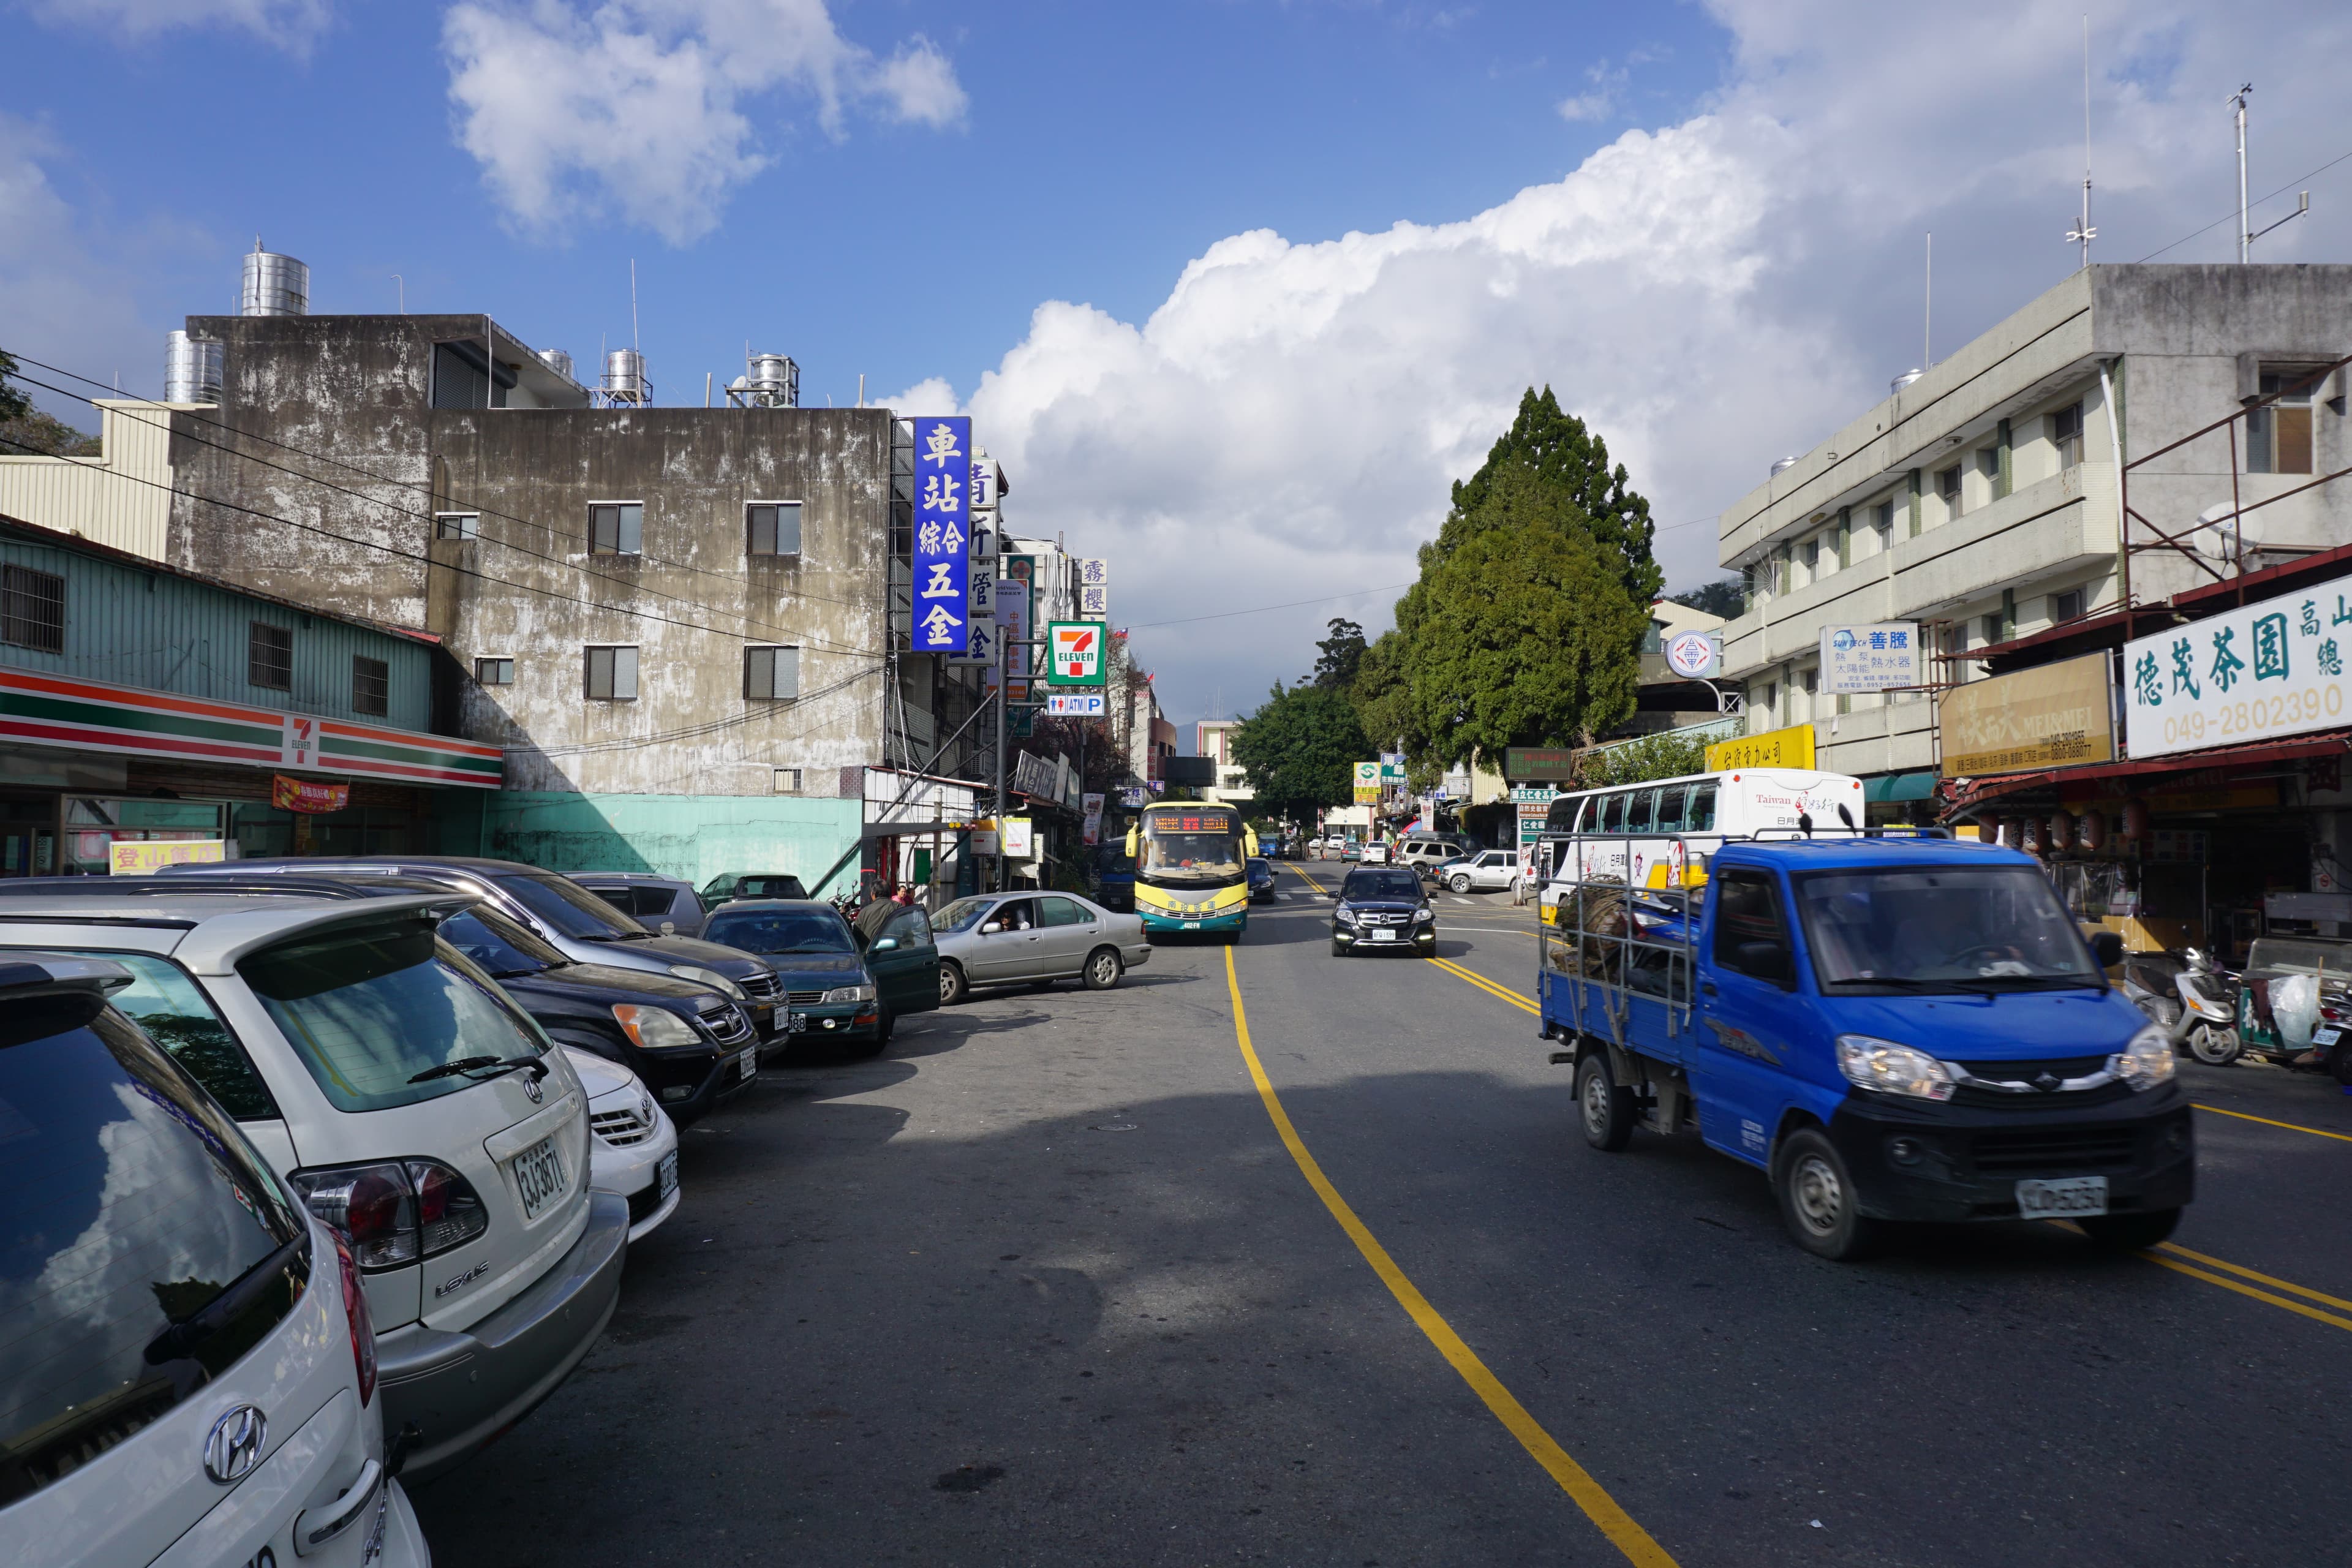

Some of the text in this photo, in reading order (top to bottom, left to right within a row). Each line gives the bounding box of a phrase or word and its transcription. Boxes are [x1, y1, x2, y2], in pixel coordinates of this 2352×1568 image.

[919, 423, 965, 646] 車站綜合五金
[1084, 560, 1104, 621] 霧櫻
[1869, 631, 1907, 649] 善騰
[1872, 657, 1910, 668] 熱水器
[2134, 612, 2290, 706] 德茂茶園
[1836, 664, 1869, 673] 太陽能
[1069, 699, 1083, 710] ATM
[1088, 699, 1101, 711] P
[2023, 707, 2094, 738] MEI&MEI
[2164, 684, 2342, 744] 049-2802390
[2051, 744, 2092, 761] 0800-088077
[1756, 794, 1791, 805] Taiwan
[1168, 901, 1216, 911] 南投客運
[434, 1261, 489, 1298] LEXUS
